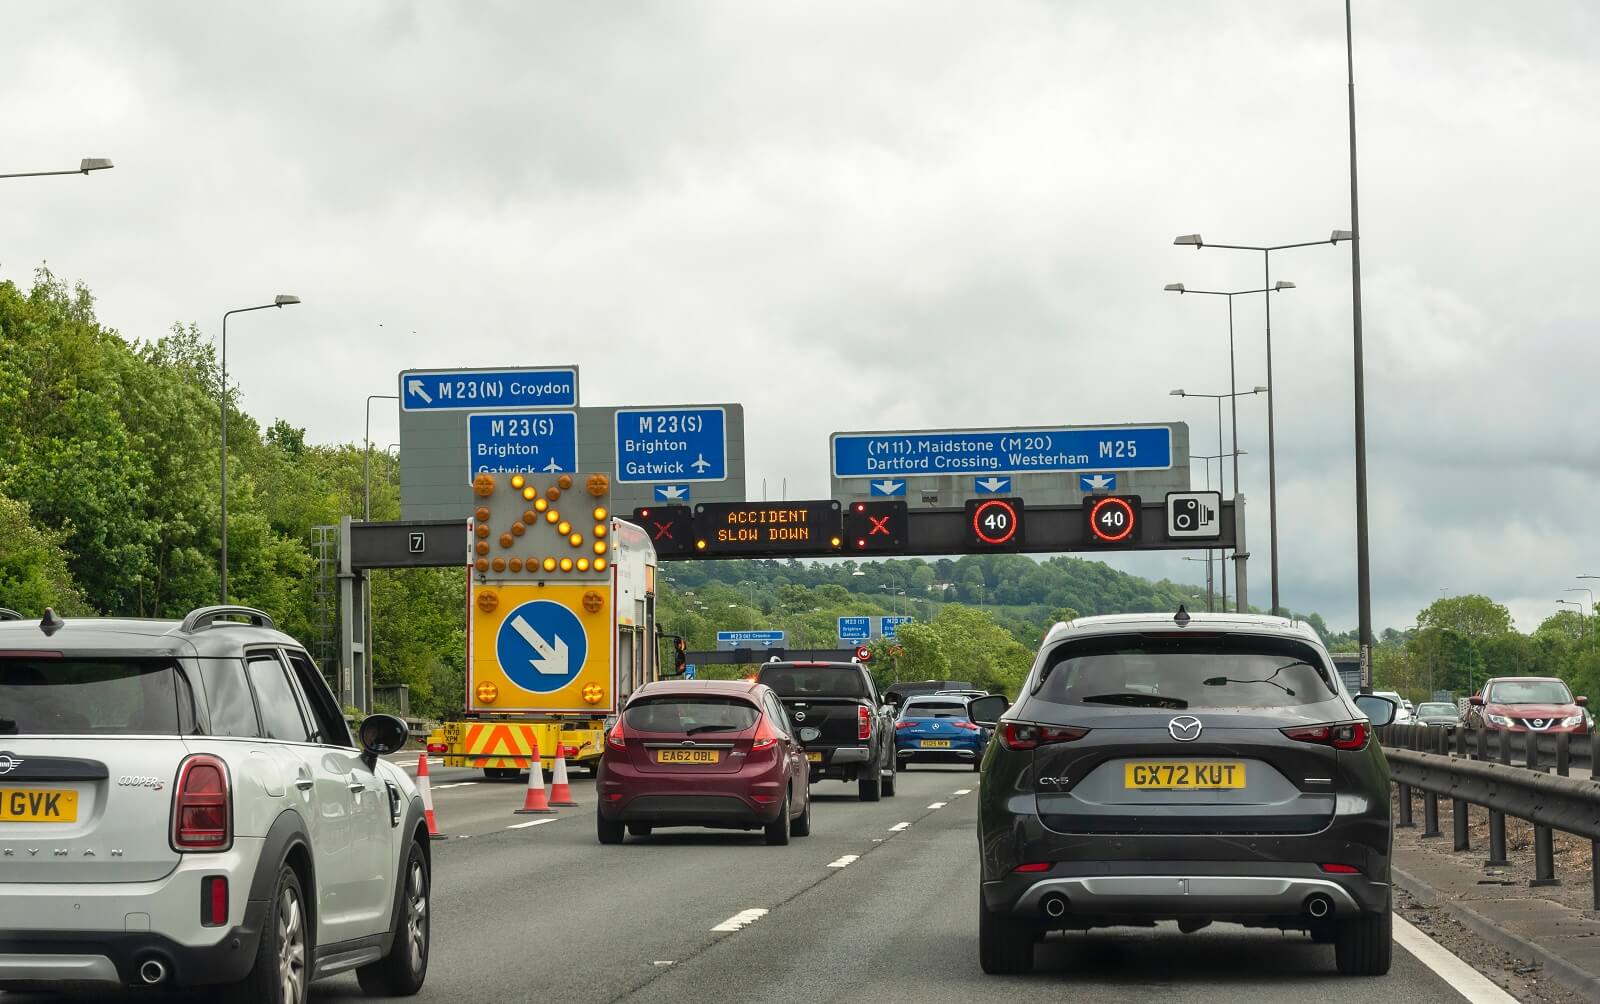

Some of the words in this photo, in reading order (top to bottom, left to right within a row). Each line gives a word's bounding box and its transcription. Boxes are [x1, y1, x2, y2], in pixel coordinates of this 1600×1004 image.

[510, 382, 570, 397] Croydon
[477, 443, 539, 458] Brighton
[625, 439, 687, 454] Brighton
[918, 440, 994, 453] Maidstone
[1099, 441, 1137, 458] M25
[626, 461, 684, 474] Gatwick
[867, 456, 929, 470] Dartford
[935, 455, 1002, 469] Crossing,
[1008, 453, 1089, 466] Westerham
[728, 510, 808, 524] ACCIDENT
[985, 514, 1007, 529] 40
[1102, 511, 1124, 527] 40
[718, 528, 758, 541] SLOW
[769, 527, 809, 541] DOWN
[412, 536, 422, 549] 7
[662, 751, 691, 761] EA62
[693, 751, 715, 761] OBL
[1039, 776, 1069, 785] CX-5
[1133, 765, 1189, 785] GX72
[1195, 765, 1236, 785] KUT
[10, 791, 61, 817] GVK
